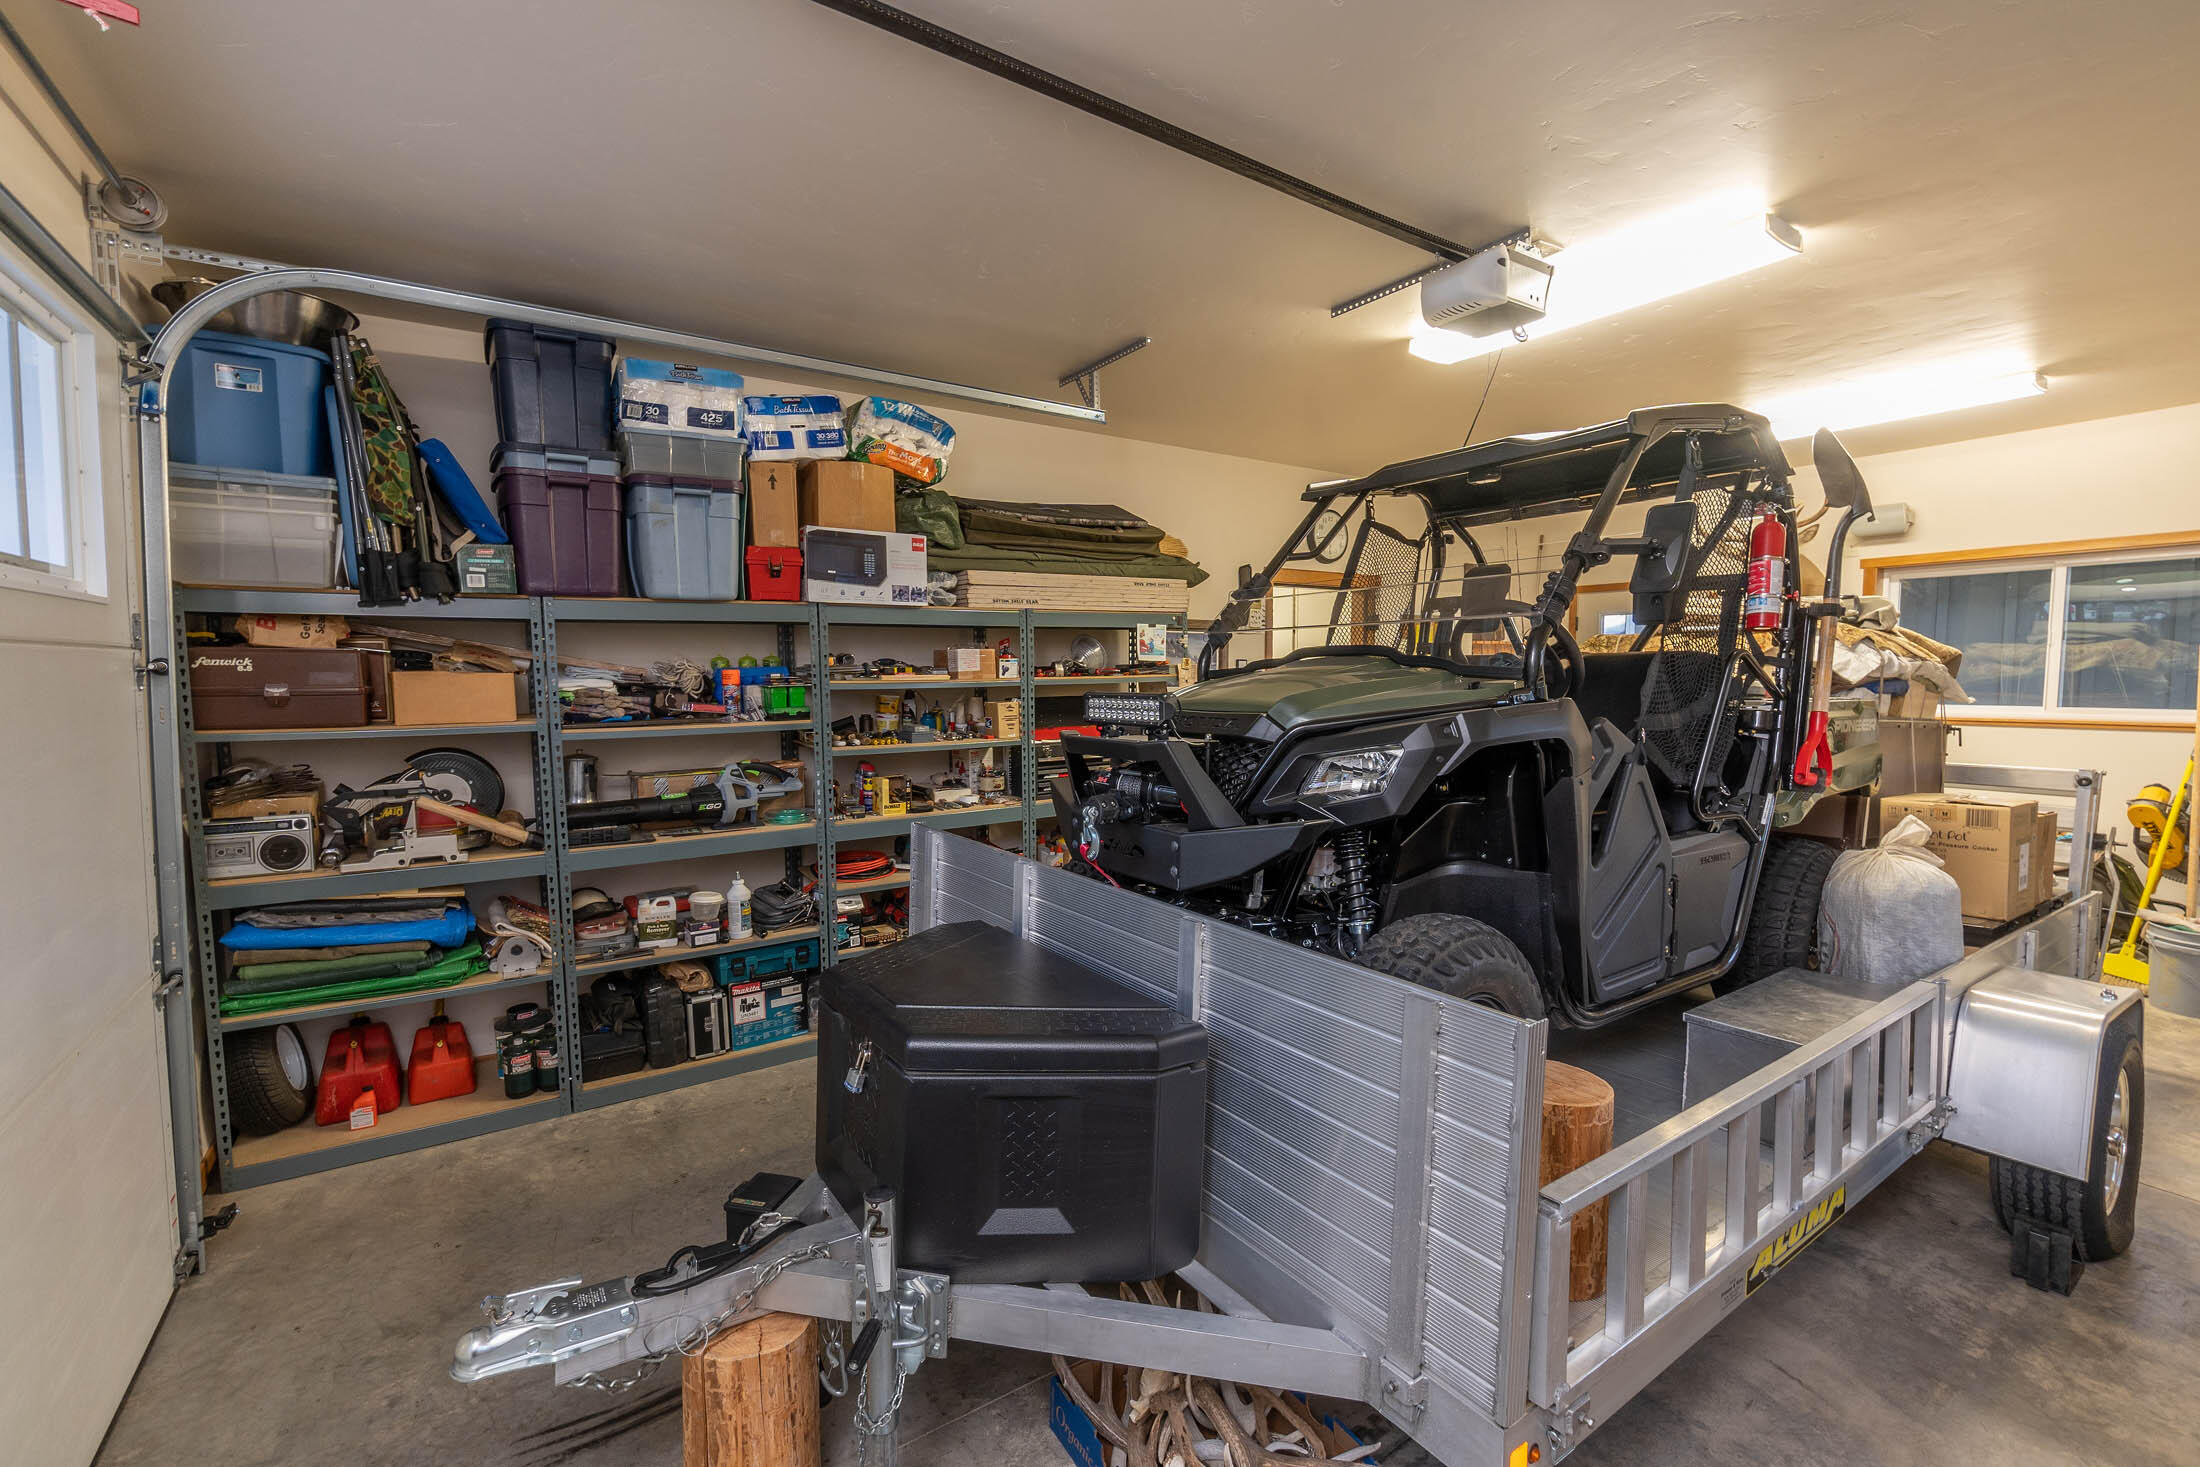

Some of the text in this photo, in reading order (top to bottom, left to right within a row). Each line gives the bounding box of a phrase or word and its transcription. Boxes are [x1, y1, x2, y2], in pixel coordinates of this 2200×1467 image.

[645, 406, 660, 417] 30
[773, 404, 814, 415] Bath Tissue
[701, 412, 723, 424] 425
[191, 656, 253, 669] fenwick
[698, 802, 722, 811] EGO
[1947, 831, 1967, 841] Pot
[732, 985, 761, 995] makita
[1750, 1186, 1845, 1281] ALUMA
